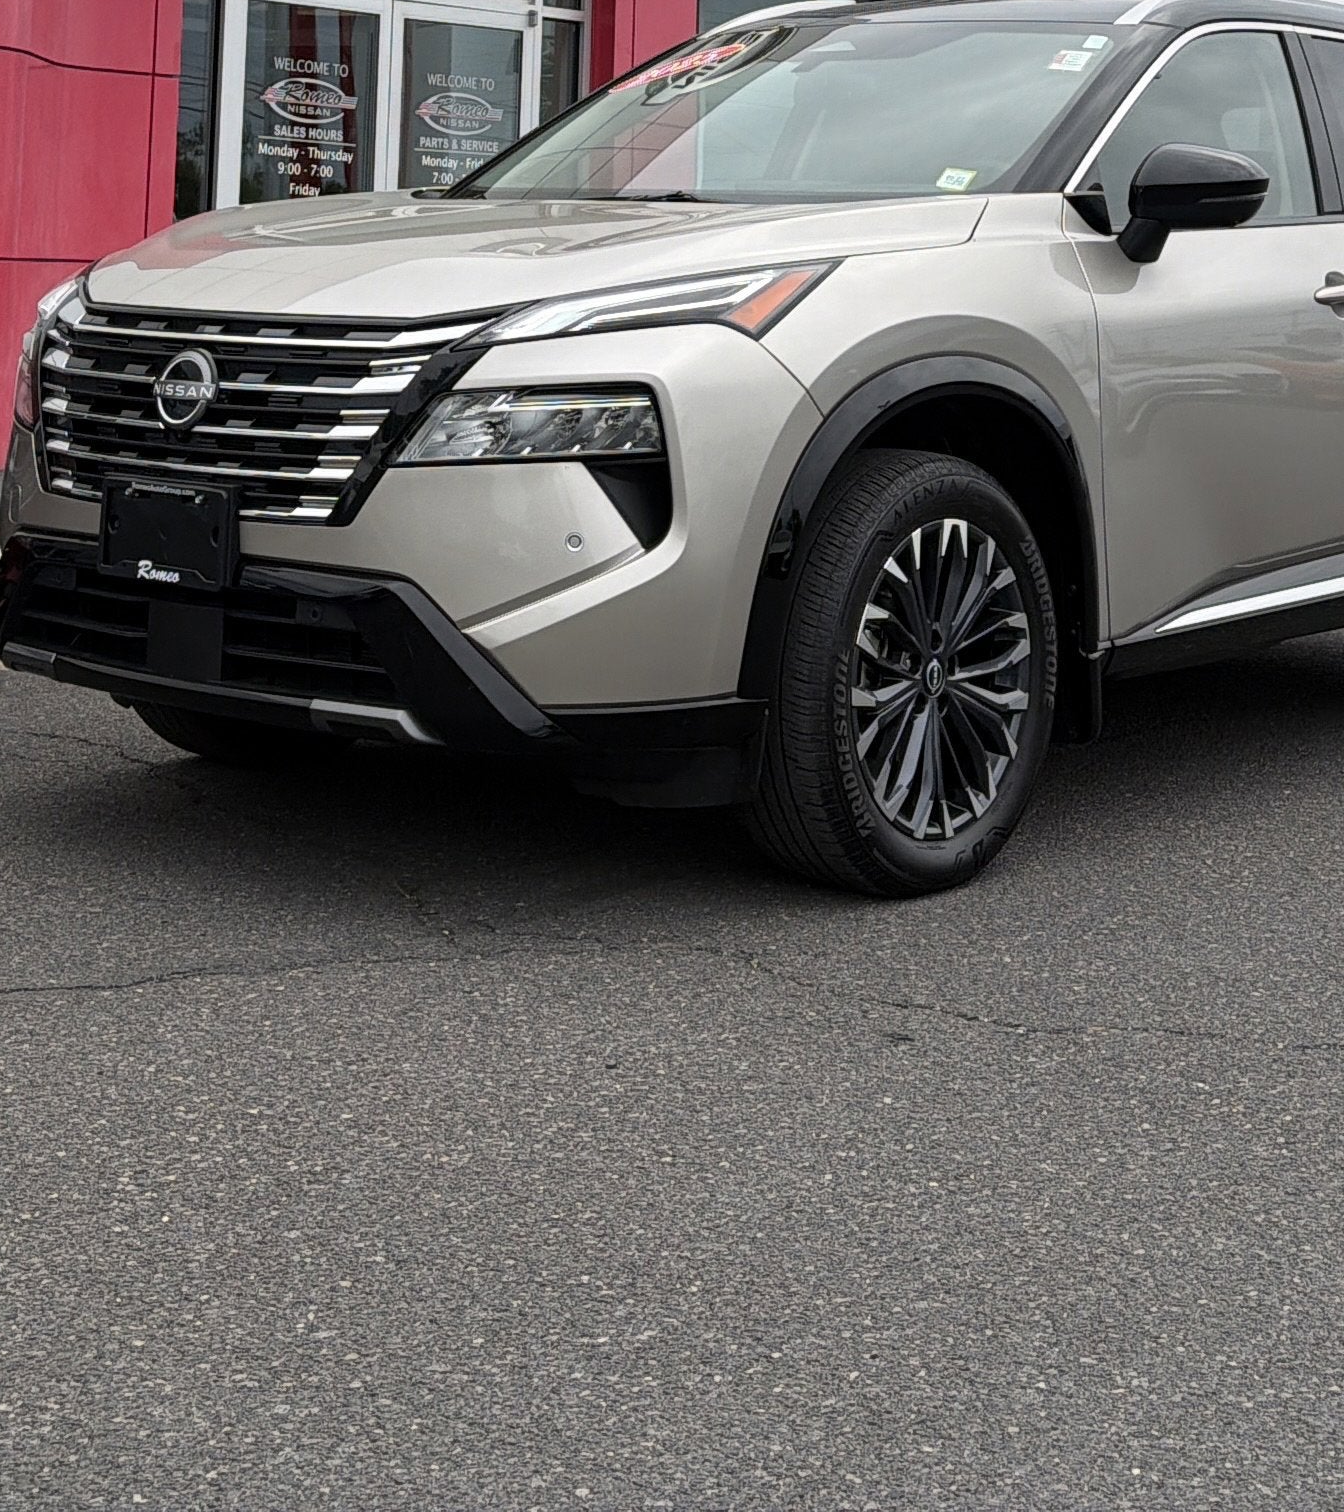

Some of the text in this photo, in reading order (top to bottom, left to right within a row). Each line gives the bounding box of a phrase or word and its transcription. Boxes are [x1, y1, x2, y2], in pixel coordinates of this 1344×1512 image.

[274, 56, 349, 78] WELCOME TO
[427, 73, 495, 91] WELCOME TO
[276, 80, 343, 106] Romeo
[287, 104, 331, 117] NISSAN
[436, 96, 489, 118] Romeo
[439, 117, 480, 129] NISSAN
[273, 124, 344, 141] SALES HOURS
[258, 142, 299, 159] Monday
[307, 146, 354, 164] Thursday
[419, 136, 499, 153] PARTS & SERVICE
[277, 161, 302, 176] 9:00
[310, 165, 334, 178] 7:00
[421, 155, 459, 170] Monday
[432, 172, 454, 185] 7:00
[289, 183, 321, 197] Friday
[153, 382, 213, 399] NISSAN
[137, 559, 180, 583] Romeo
[1019, 537, 1058, 712] BRIDGESTONE
[832, 648, 877, 839] BRIDGESTONE
